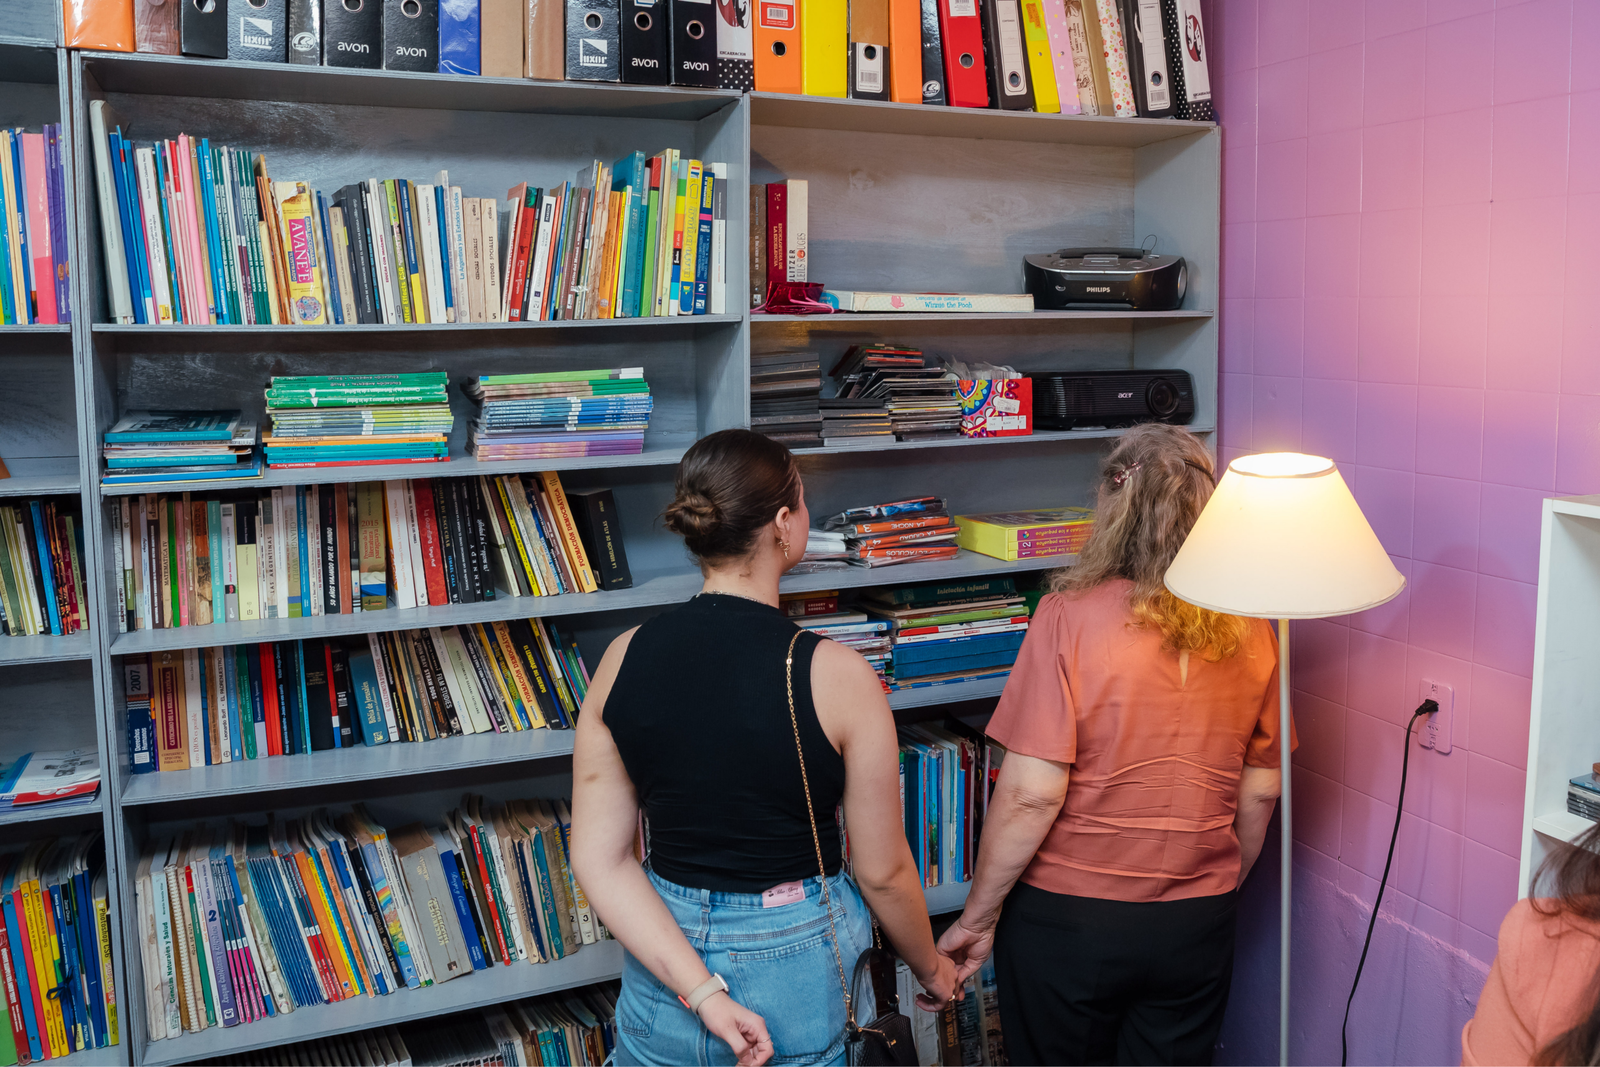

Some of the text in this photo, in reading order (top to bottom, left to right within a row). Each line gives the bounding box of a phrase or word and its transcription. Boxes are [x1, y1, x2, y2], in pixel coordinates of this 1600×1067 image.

[337, 41, 369, 53] avon
[396, 45, 427, 57] avon
[632, 57, 659, 68] avon
[683, 60, 709, 71] avon
[457, 246, 465, 272] Argentina
[399, 281, 408, 304] Effects
[402, 305, 411, 322] After
[551, 487, 573, 531] DEMOCRÁTICA
[863, 524, 872, 532] 3
[366, 530, 374, 557] literatura
[372, 528, 381, 558] paraguaya
[567, 531, 586, 567] FORMACIÓN
[469, 543, 481, 594] KENNEDY
[936, 582, 990, 596] Iniciación infantil
[497, 625, 518, 669] DEMOCRÁTICA
[129, 669, 141, 691] 2007
[216, 656, 225, 694] PADRENUESTRO
[524, 648, 537, 670] LENGUAJE
[535, 675, 546, 693] CUERPO
[360, 680, 374, 703] Jerusalén
[423, 668, 437, 700] STRAW DOGS
[436, 672, 452, 709] FILM STUDIES
[514, 668, 532, 703] FORMACIÓN
[366, 709, 376, 724] Biblia
[133, 728, 141, 751] Derechos
[140, 727, 148, 750] Humanos
[167, 721, 176, 745] CATECISMO
[484, 882, 494, 902] Geología
[97, 907, 109, 942] Photoshop
[206, 908, 217, 922] 2
[372, 911, 384, 934] ESTUDIOS
[425, 896, 450, 946] KISSINGER
[582, 914, 589, 922] 3
[160, 921, 169, 939] Salud
[163, 945, 173, 976] Naturales
[166, 976, 176, 1003] Ciencias
[943, 1012, 957, 1048] Cartas de
